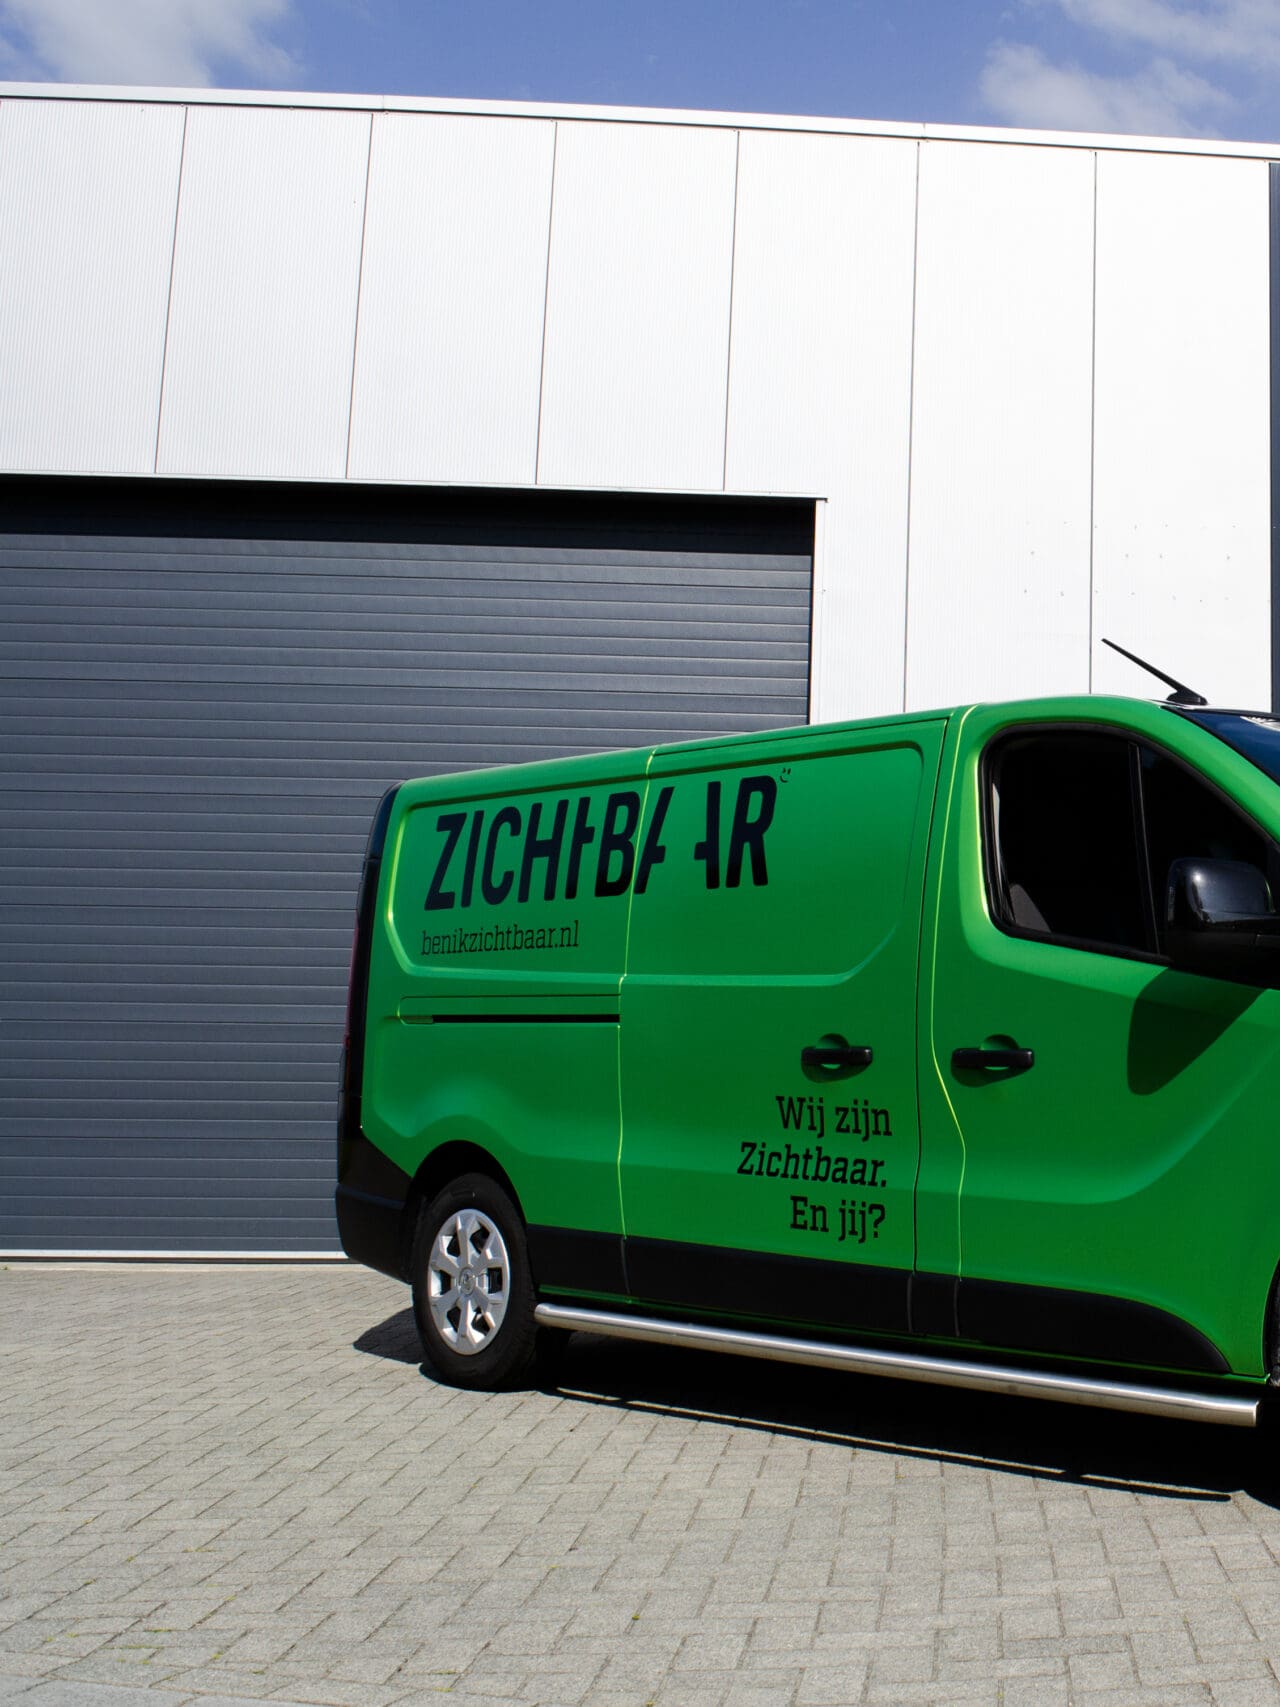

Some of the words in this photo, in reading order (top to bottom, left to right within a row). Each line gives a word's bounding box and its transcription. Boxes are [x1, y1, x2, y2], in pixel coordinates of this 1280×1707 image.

[420, 919, 580, 956] benikzichtbaar.nl
[775, 1095, 825, 1139] Wij
[834, 1098, 893, 1143] zijn
[736, 1141, 887, 1188] Zichtbaar.
[789, 1194, 830, 1233] En
[837, 1199, 886, 1244] jij?
